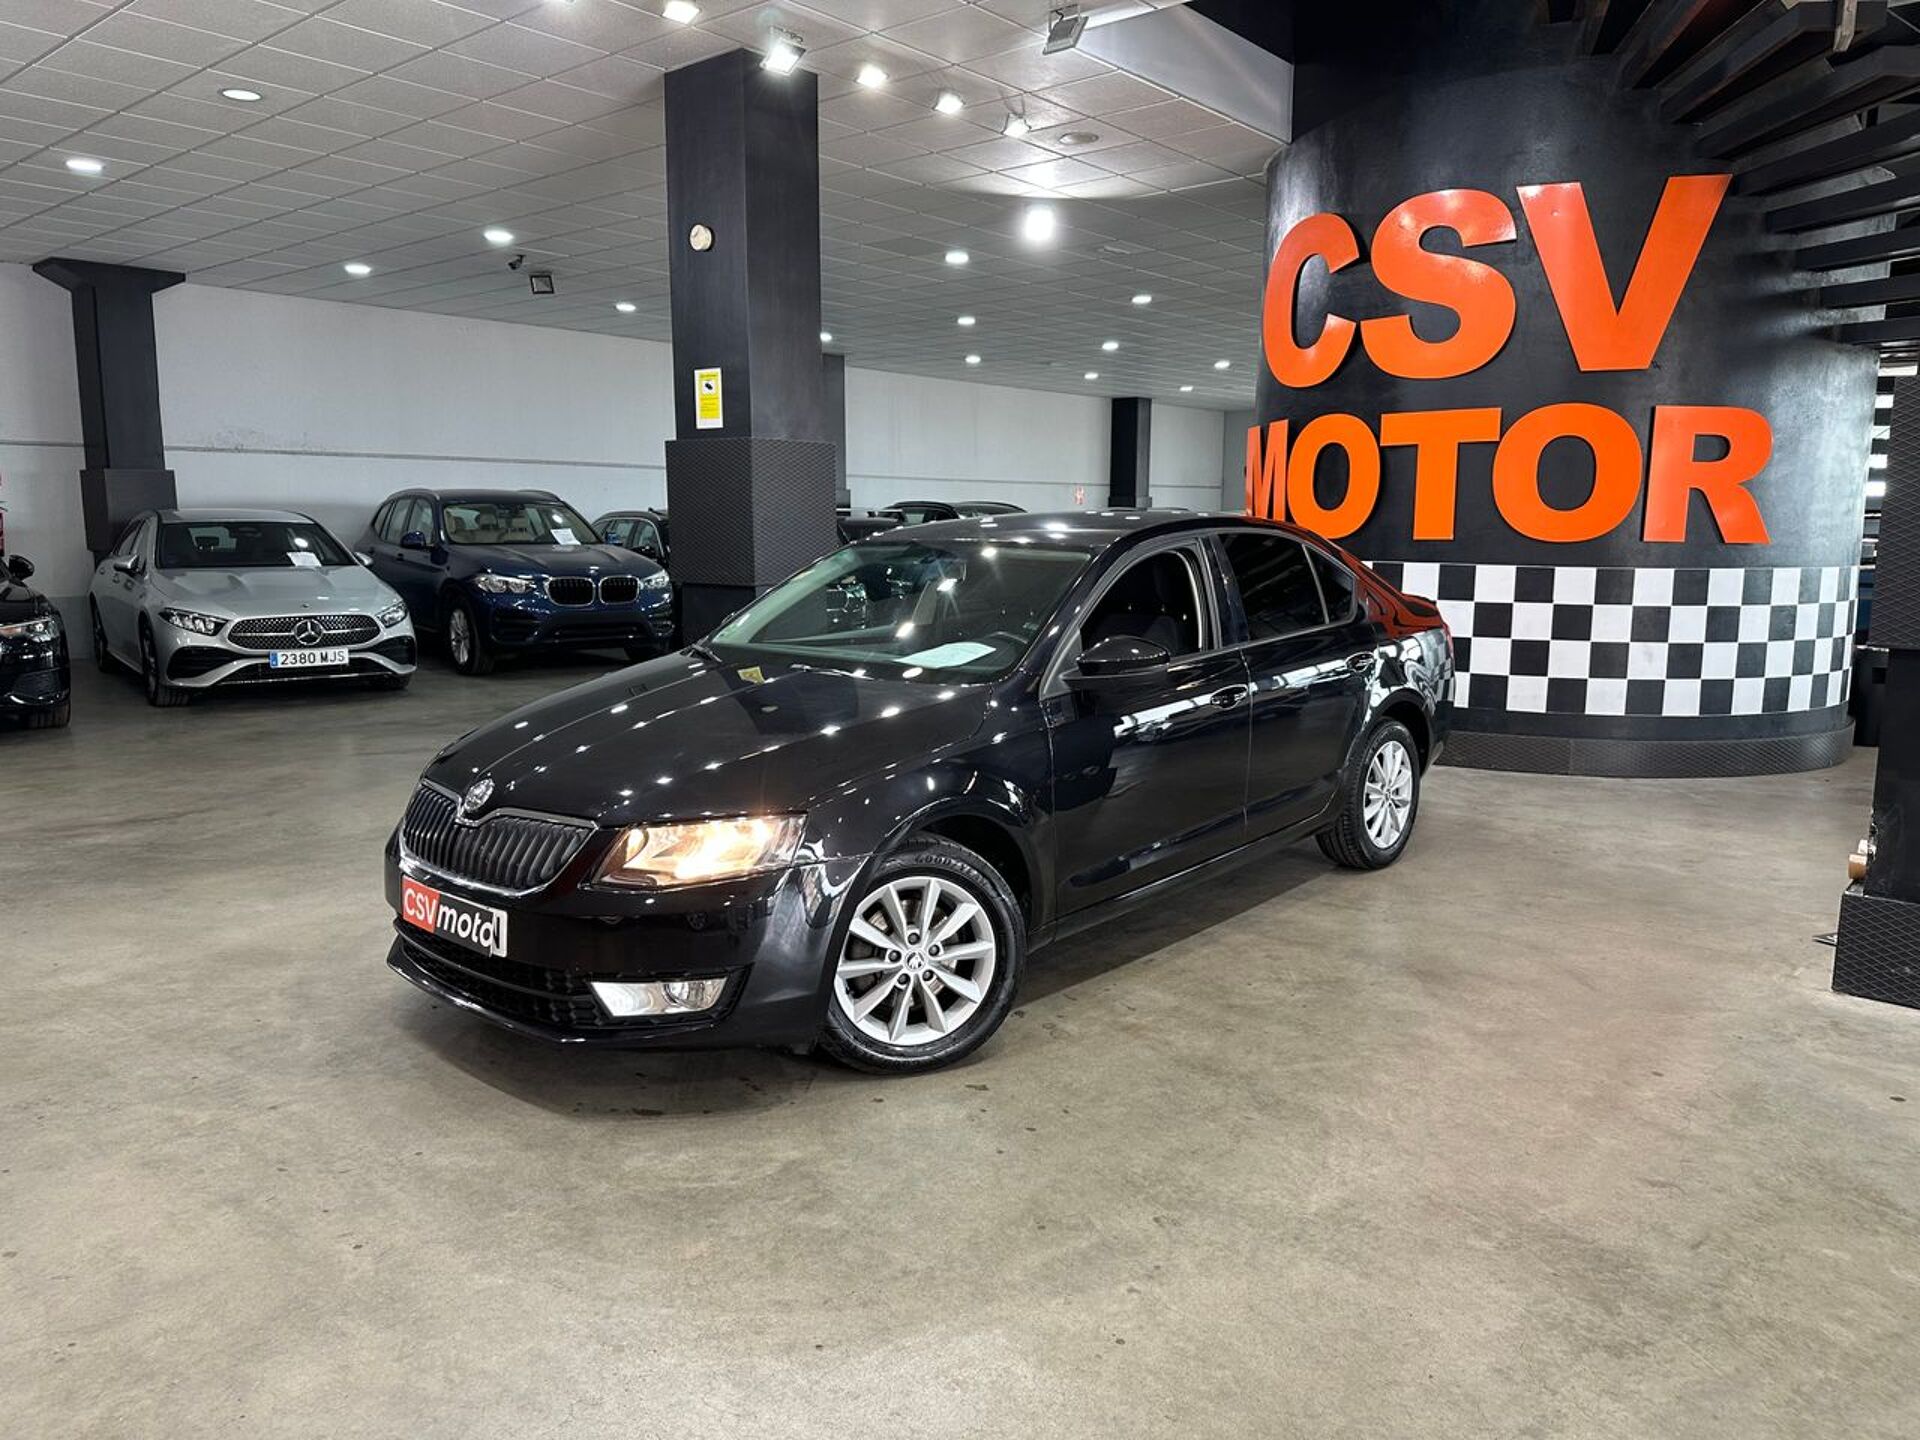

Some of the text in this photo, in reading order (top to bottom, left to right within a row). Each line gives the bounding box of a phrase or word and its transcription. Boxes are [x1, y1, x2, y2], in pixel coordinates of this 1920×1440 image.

[1263, 173, 1733, 388] CSV
[1246, 402, 1773, 545] MOTOR
[281, 651, 345, 665] 2380 MJS
[404, 888, 494, 947] CSVmoto
